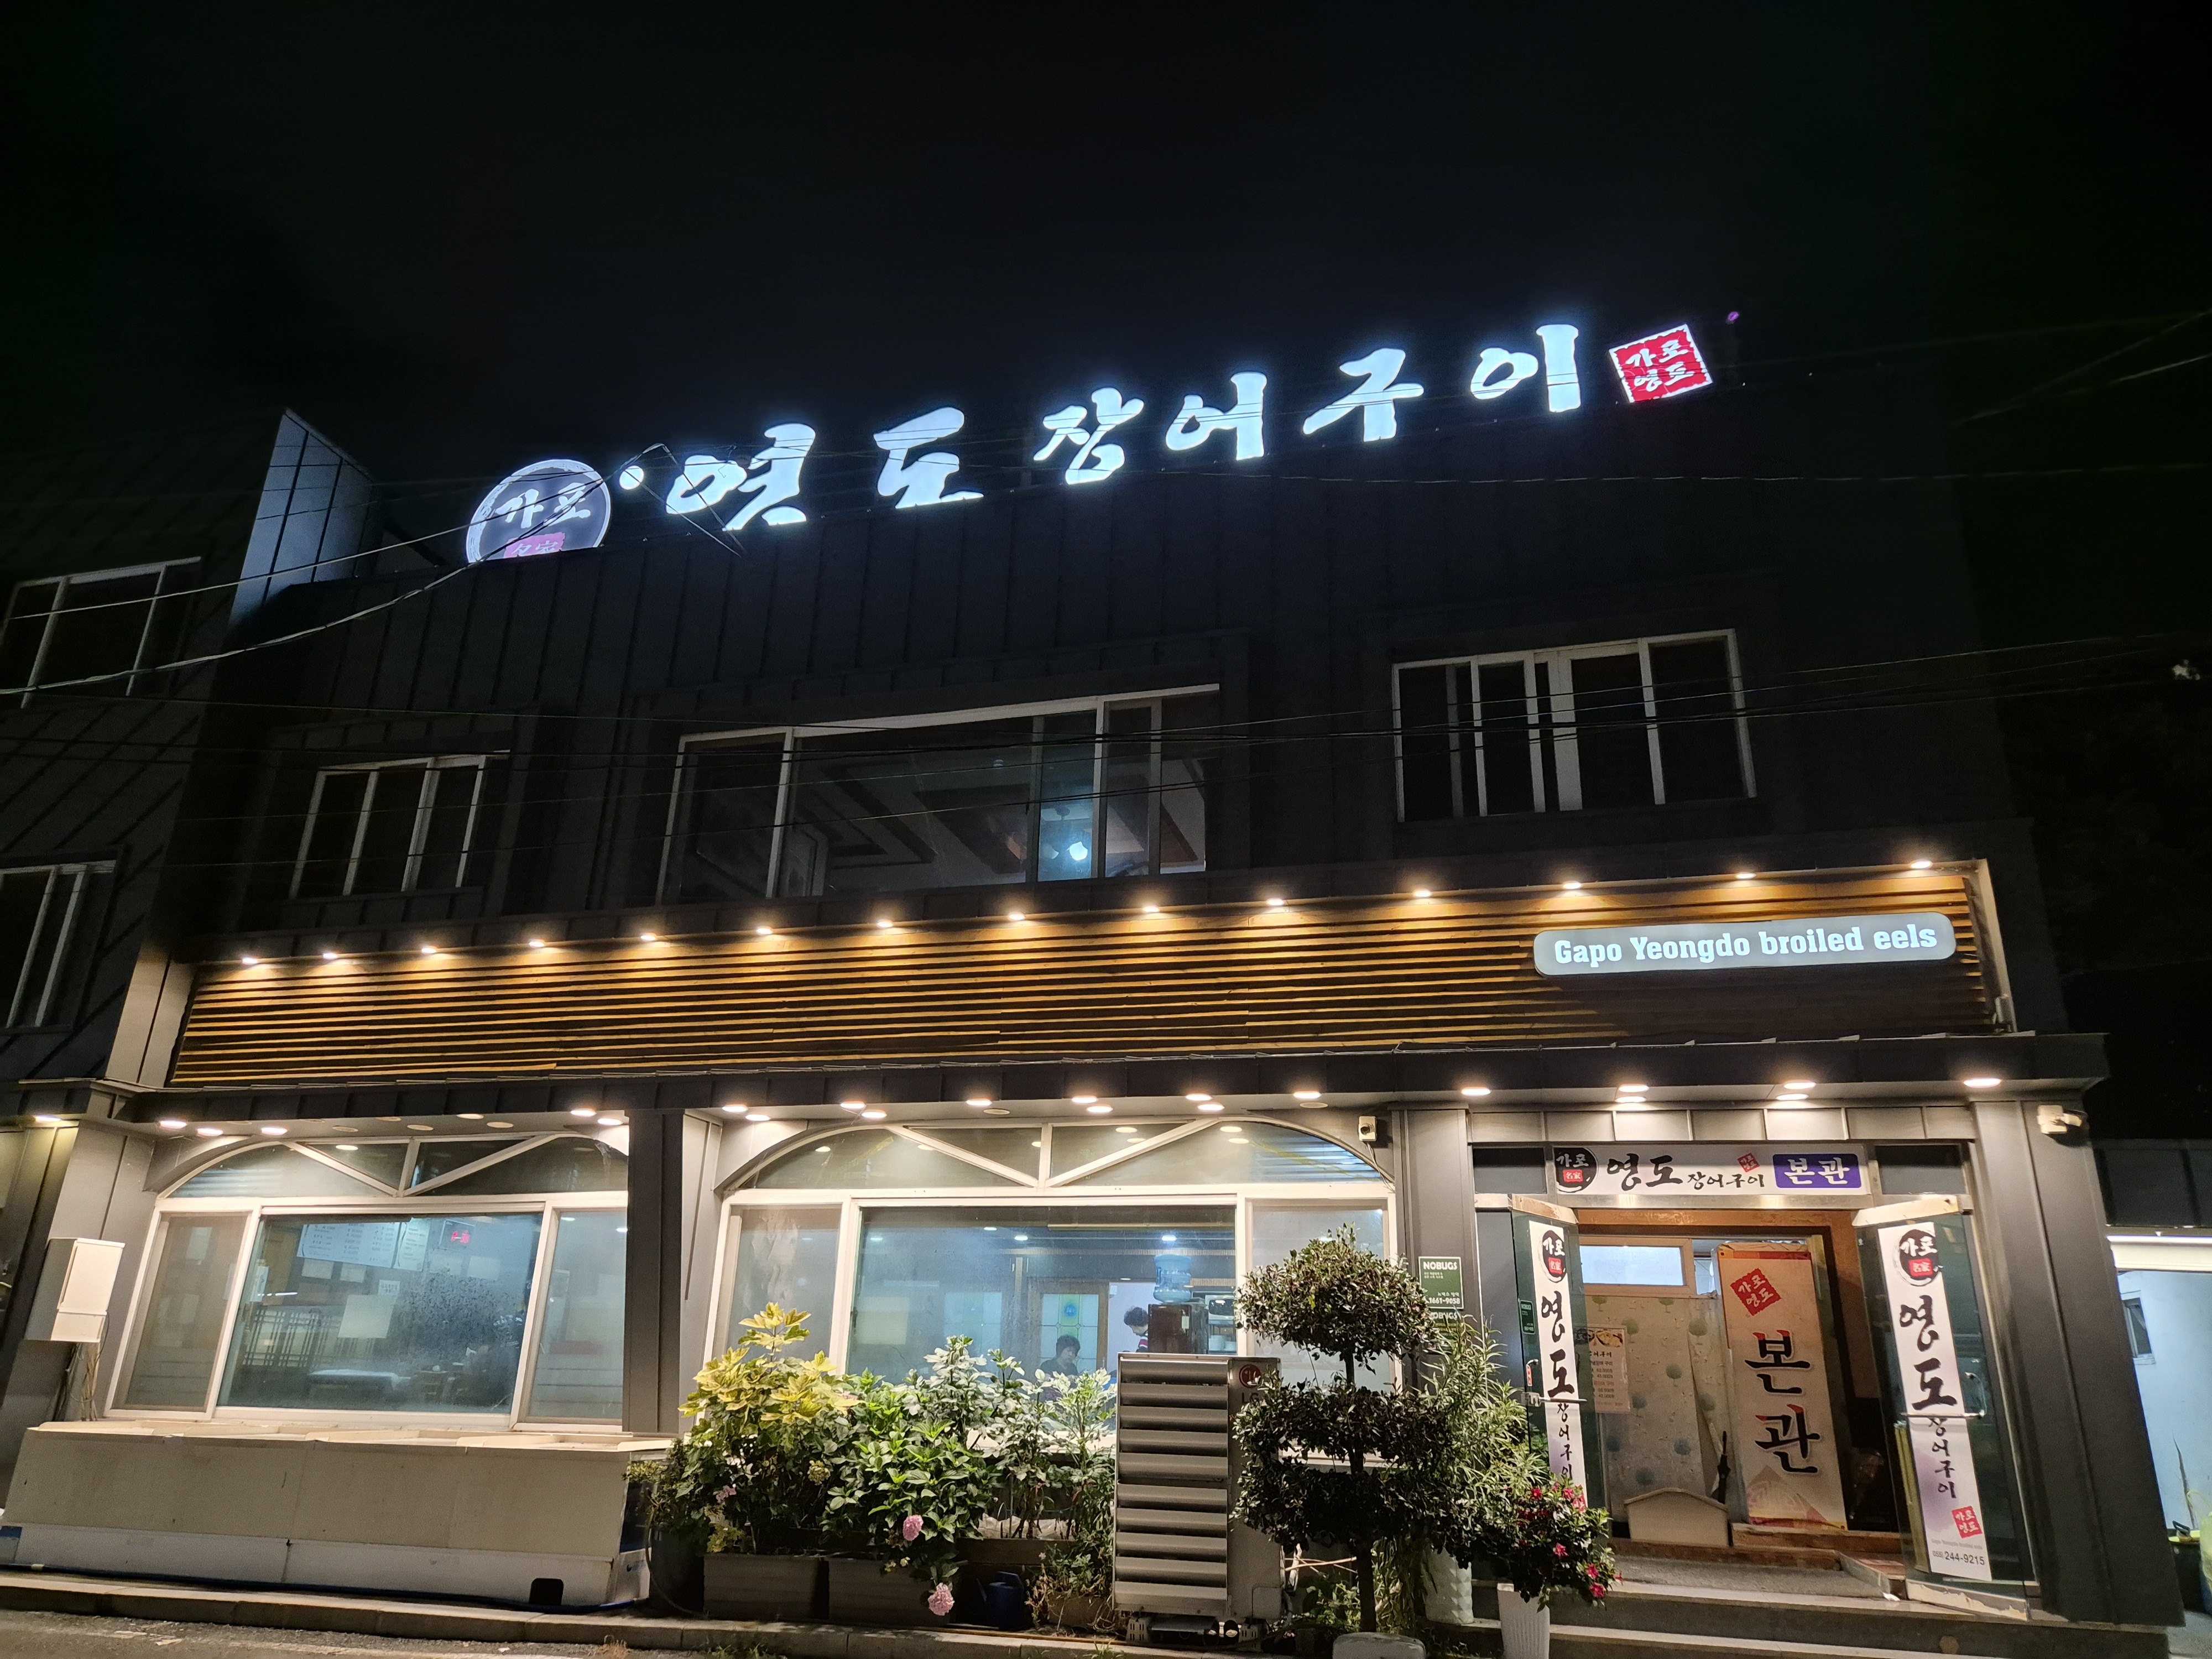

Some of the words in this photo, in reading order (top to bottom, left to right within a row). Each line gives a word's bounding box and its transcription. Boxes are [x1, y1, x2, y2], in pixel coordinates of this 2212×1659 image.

[1554, 940, 1622, 968] Gapo
[1630, 933, 1751, 963] Yeongdo
[1758, 927, 1864, 956] broiled
[1873, 924, 1938, 950] eels
[1556, 1153, 1589, 1167] 가포
[1606, 1152, 1683, 1191] 영도
[1687, 1171, 1765, 1190] 장어구이
[1783, 1156, 1851, 1185] 본관
[1542, 1237, 1566, 1256] 가포
[1900, 1235, 1938, 1257] 가포
[1423, 1261, 1458, 1270] NOBUGS
[1745, 1289, 1774, 1308] 영도
[1541, 1290, 1575, 1398] 영도
[1899, 1295, 1958, 1411] 영도
[1241, 1392, 1260, 1405] LG
[1744, 1329, 1822, 1475] 본관
[1557, 1402, 1573, 1481] 장어구이
[1928, 1417, 1957, 1499] 장어구이
[1944, 1551, 1985, 1566] 244-9215
